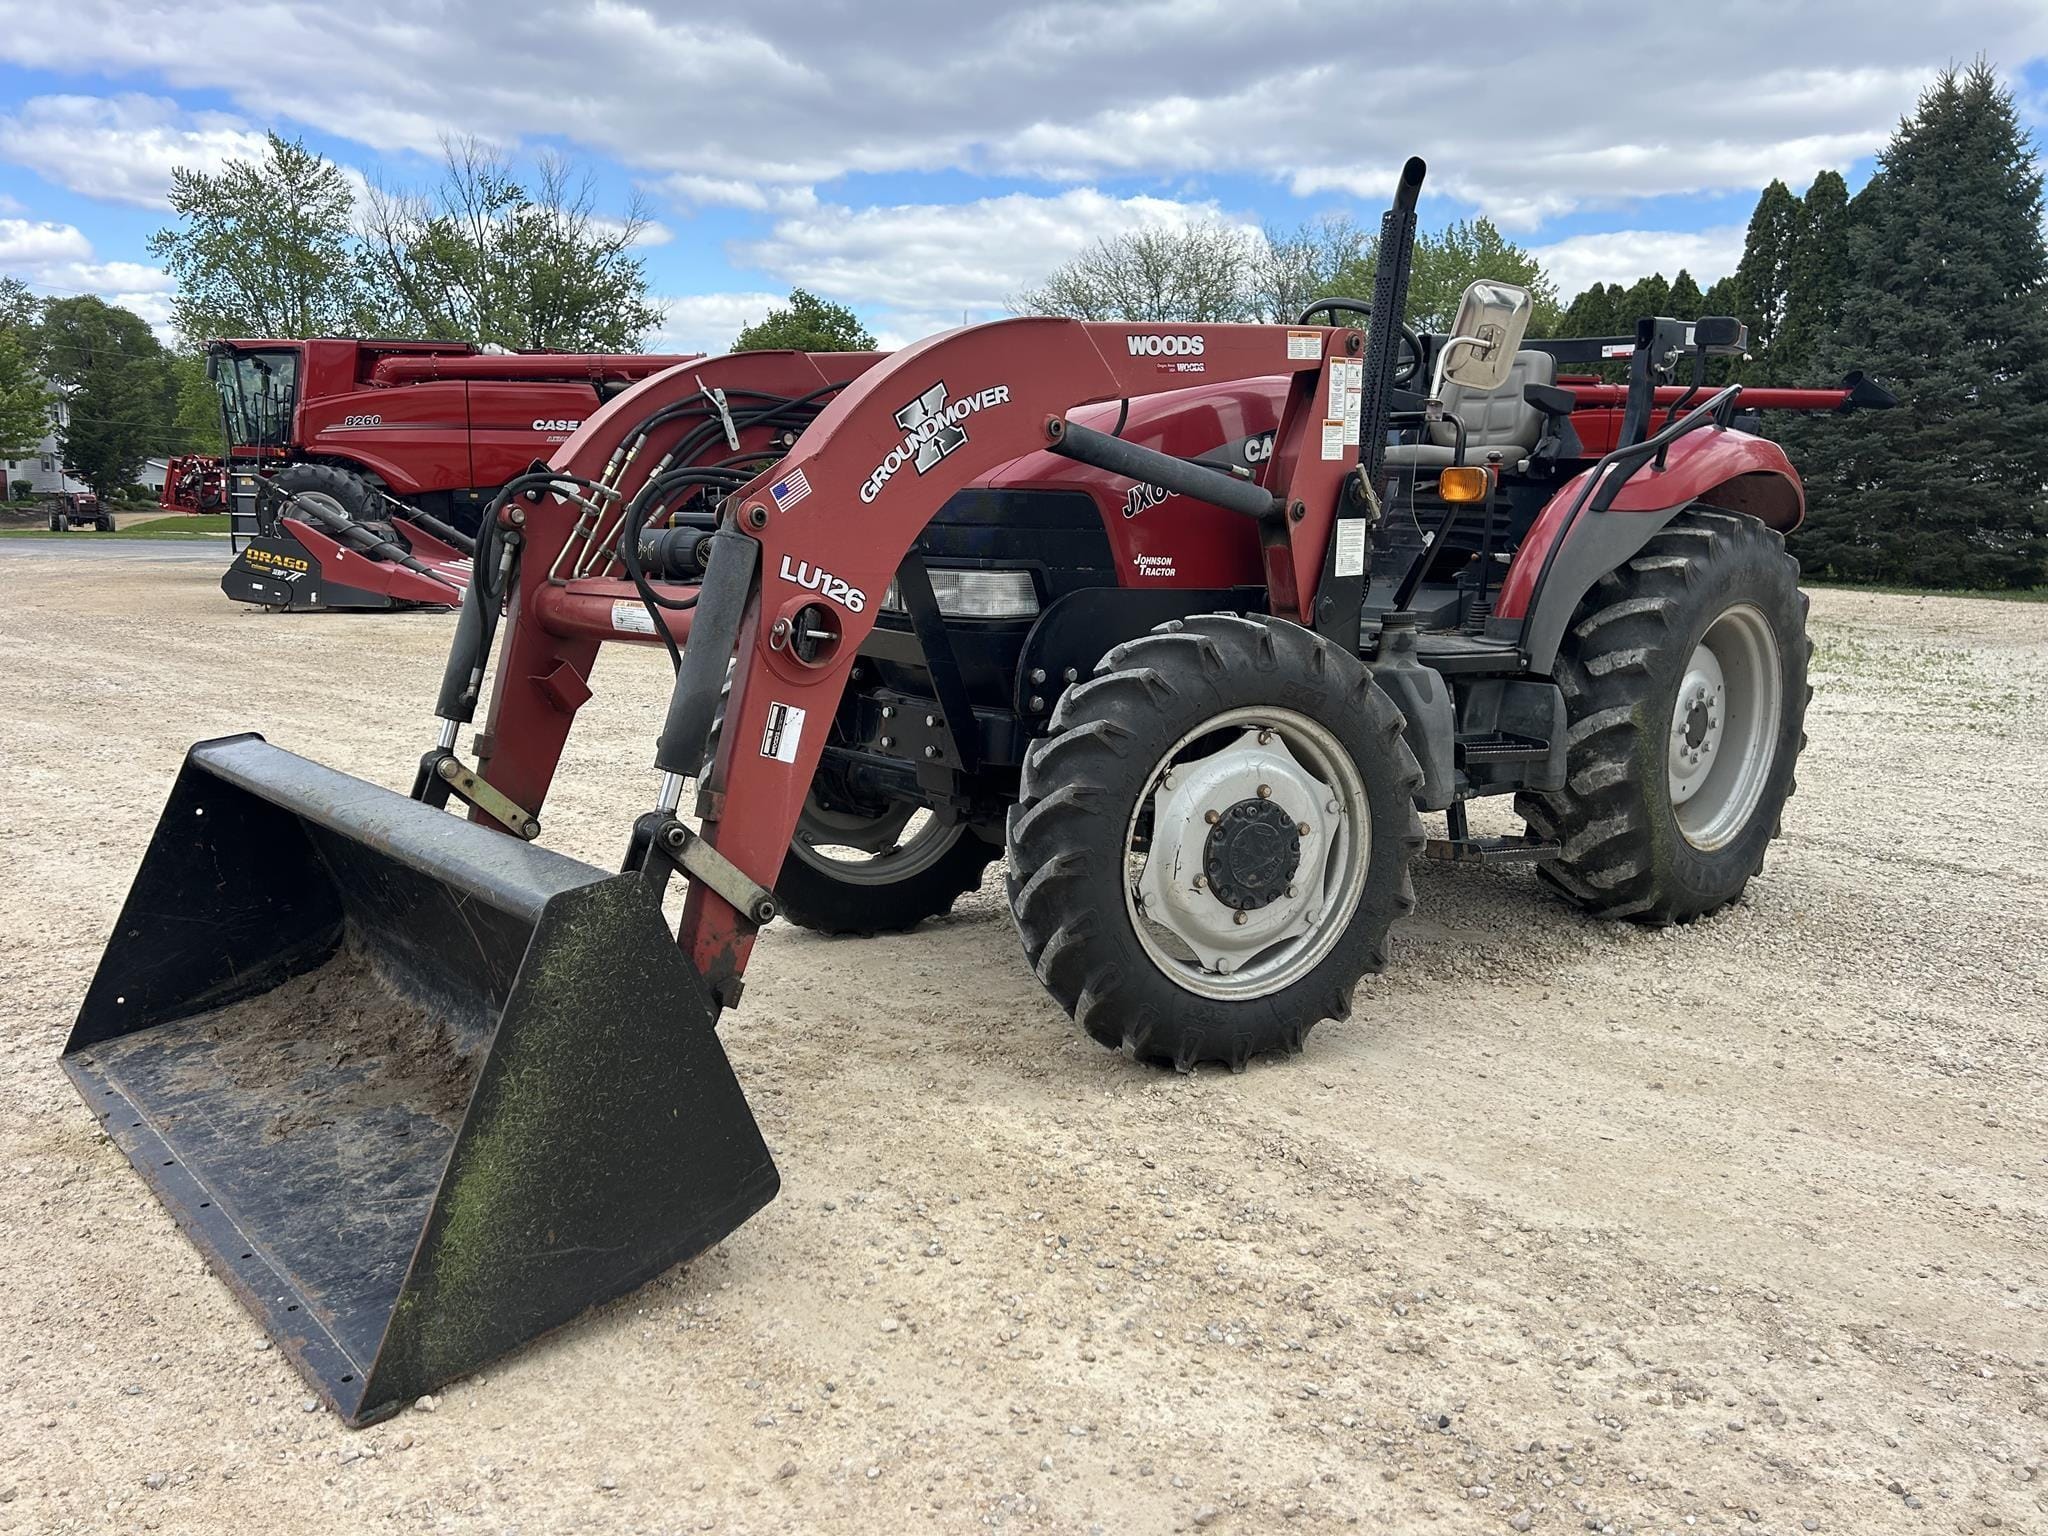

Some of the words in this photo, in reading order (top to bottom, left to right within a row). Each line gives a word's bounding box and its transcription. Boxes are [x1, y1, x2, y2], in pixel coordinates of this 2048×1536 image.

[1126, 334, 1205, 357] WOODS
[344, 414, 382, 427] 8260
[532, 419, 579, 431] CASE
[859, 384, 1013, 504] GROUNDMOVER
[1244, 433, 1274, 463] CA
[245, 548, 309, 572] DRAGO
[1133, 553, 1173, 566] JOHNSON
[1139, 564, 1176, 577] TRACTOR
[779, 554, 867, 613] LU126
